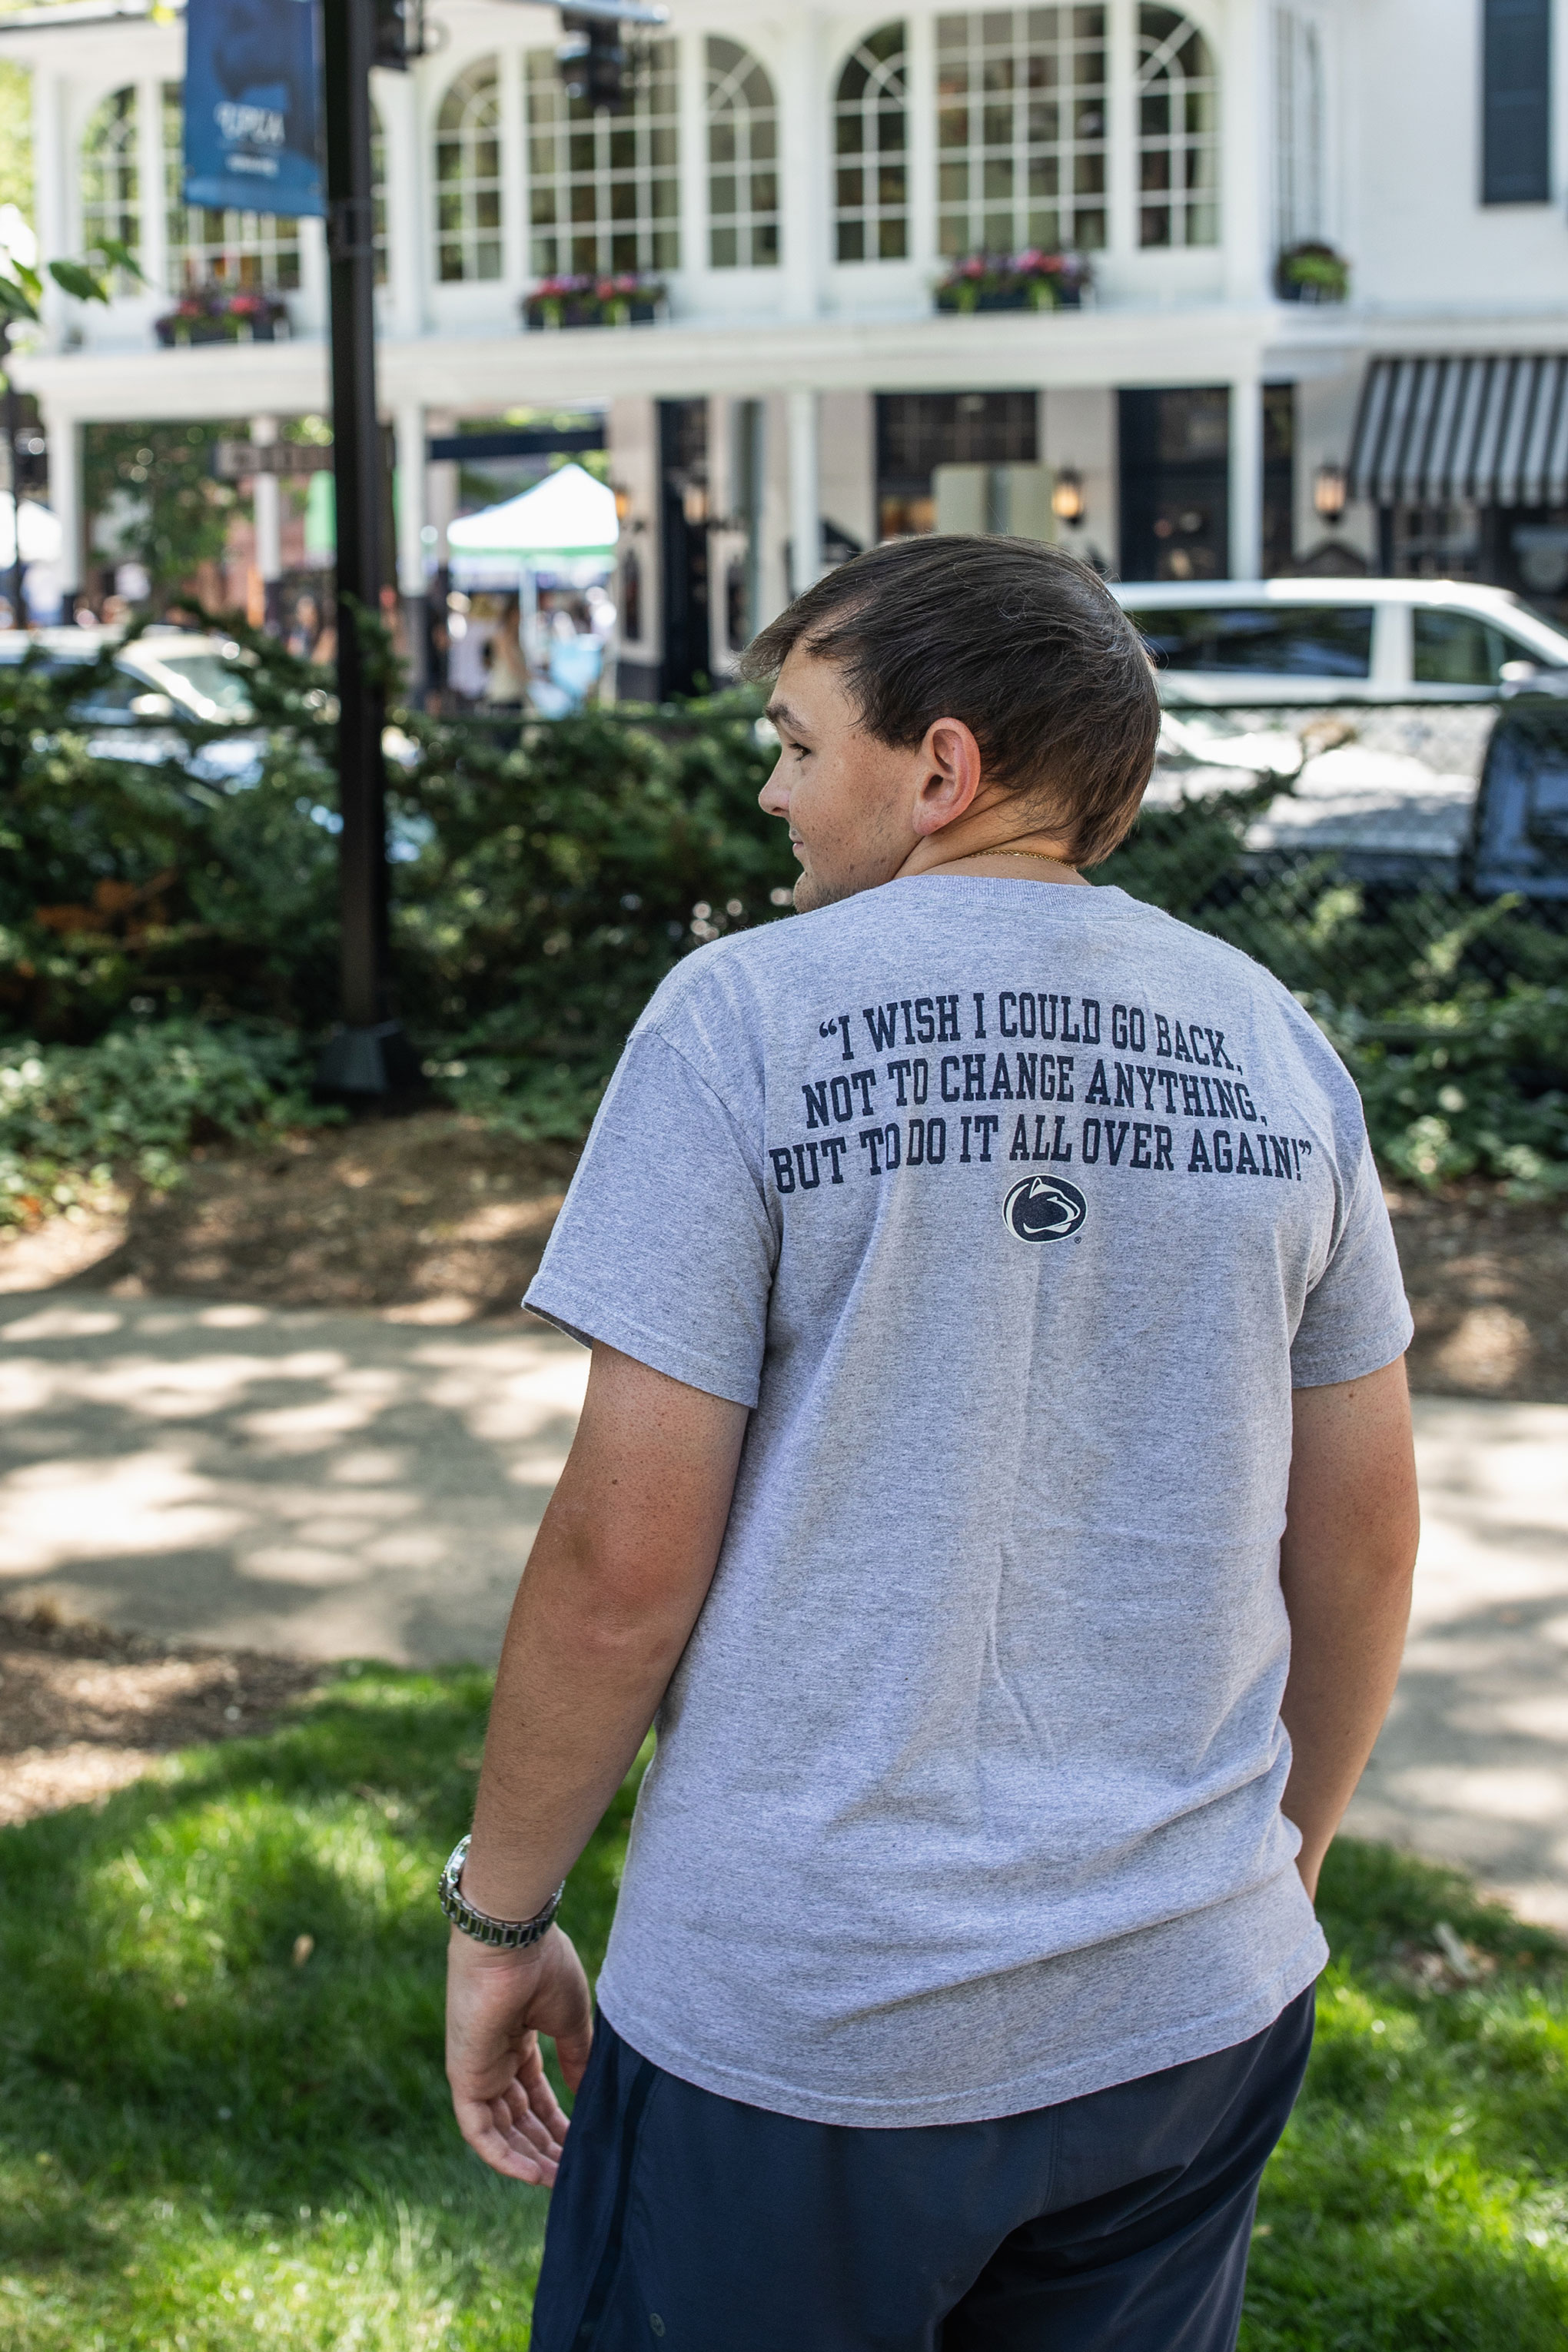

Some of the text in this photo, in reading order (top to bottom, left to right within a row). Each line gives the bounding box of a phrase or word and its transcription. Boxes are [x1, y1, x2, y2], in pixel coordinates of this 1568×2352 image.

[862, 994, 962, 1053] WISH
[972, 992, 987, 1039] I
[998, 992, 1101, 1046] COULD
[1111, 1004, 1146, 1053] GO
[1154, 1013, 1244, 1076] BACK,
[801, 1052, 1267, 1129] NOT TO CHANGE ANYTHING,
[768, 1114, 1313, 1194] BUT TO DO IT ALL OVER AGAIN!”
